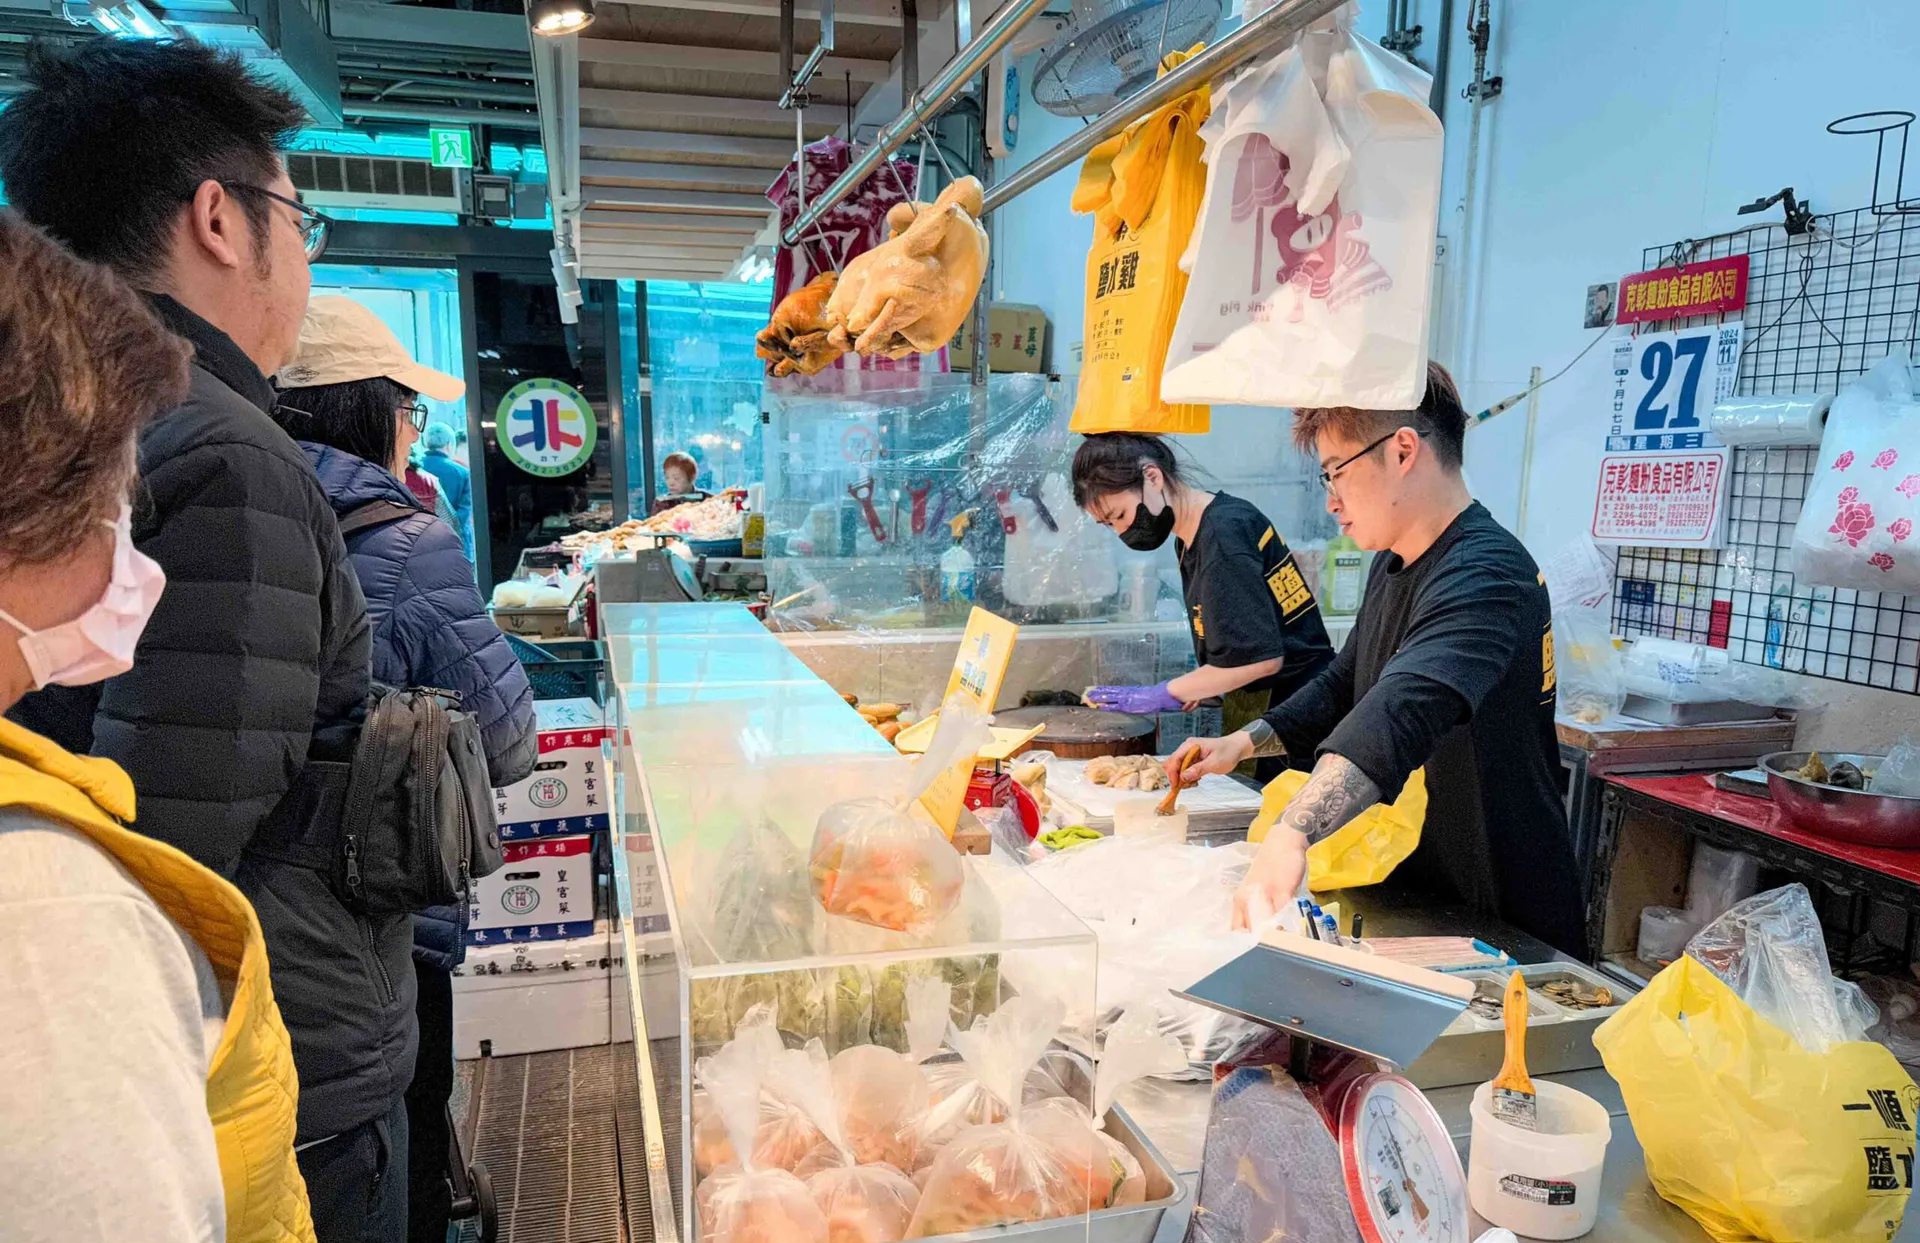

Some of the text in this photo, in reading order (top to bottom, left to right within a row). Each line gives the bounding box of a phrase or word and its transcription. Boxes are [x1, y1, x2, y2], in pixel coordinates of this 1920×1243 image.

[1096, 251, 1139, 299] 鹽水雞
[1719, 329, 1739, 339] 2024
[1719, 345, 1731, 363] 11
[1634, 335, 1711, 430] 27
[512, 399, 583, 452] 北
[1611, 377, 1626, 435] 十月廿七日
[1634, 433, 1699, 449] 星期三
[1604, 461, 1718, 494] 克彰麵粉食品有限公司
[1267, 562, 1312, 617] 鹽
[1842, 1089, 1912, 1131] 一順
